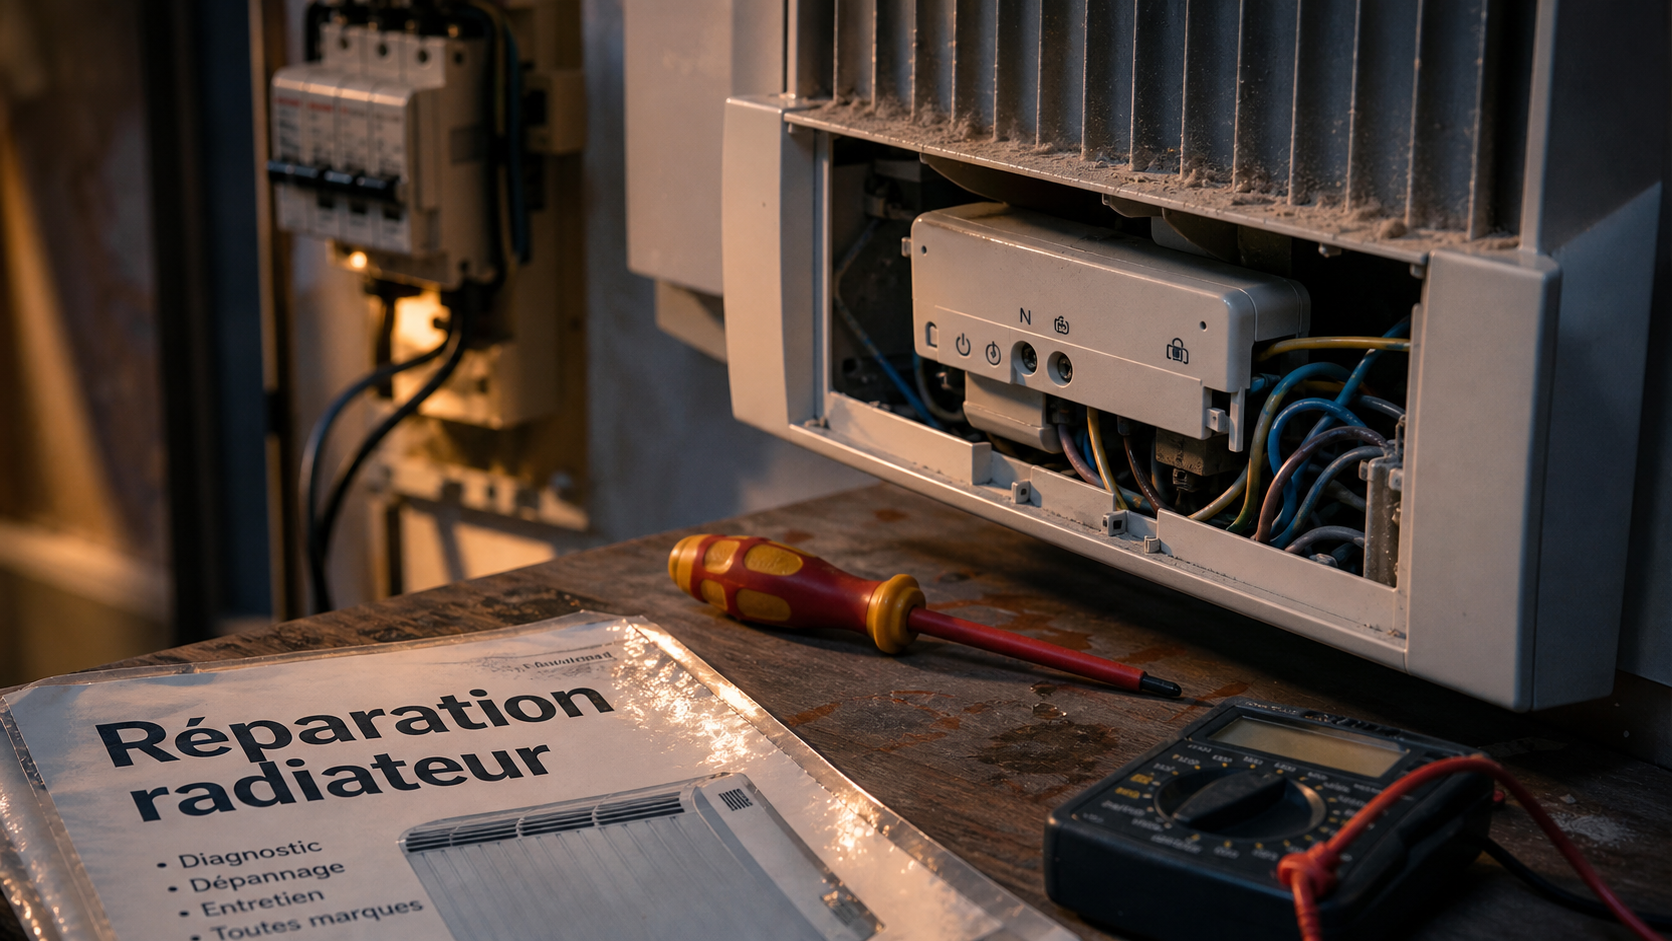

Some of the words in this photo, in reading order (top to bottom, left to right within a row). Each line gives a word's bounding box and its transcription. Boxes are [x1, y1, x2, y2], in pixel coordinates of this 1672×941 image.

[1020, 307, 1031, 326] N
[95, 687, 616, 768] Réparation
[129, 744, 551, 823] radiateur
[178, 839, 323, 869] Diagnostic
[189, 862, 346, 893] Dépannage
[200, 889, 326, 917] Entretien
[209, 916, 302, 941] Toutes
[308, 898, 424, 928] marques
